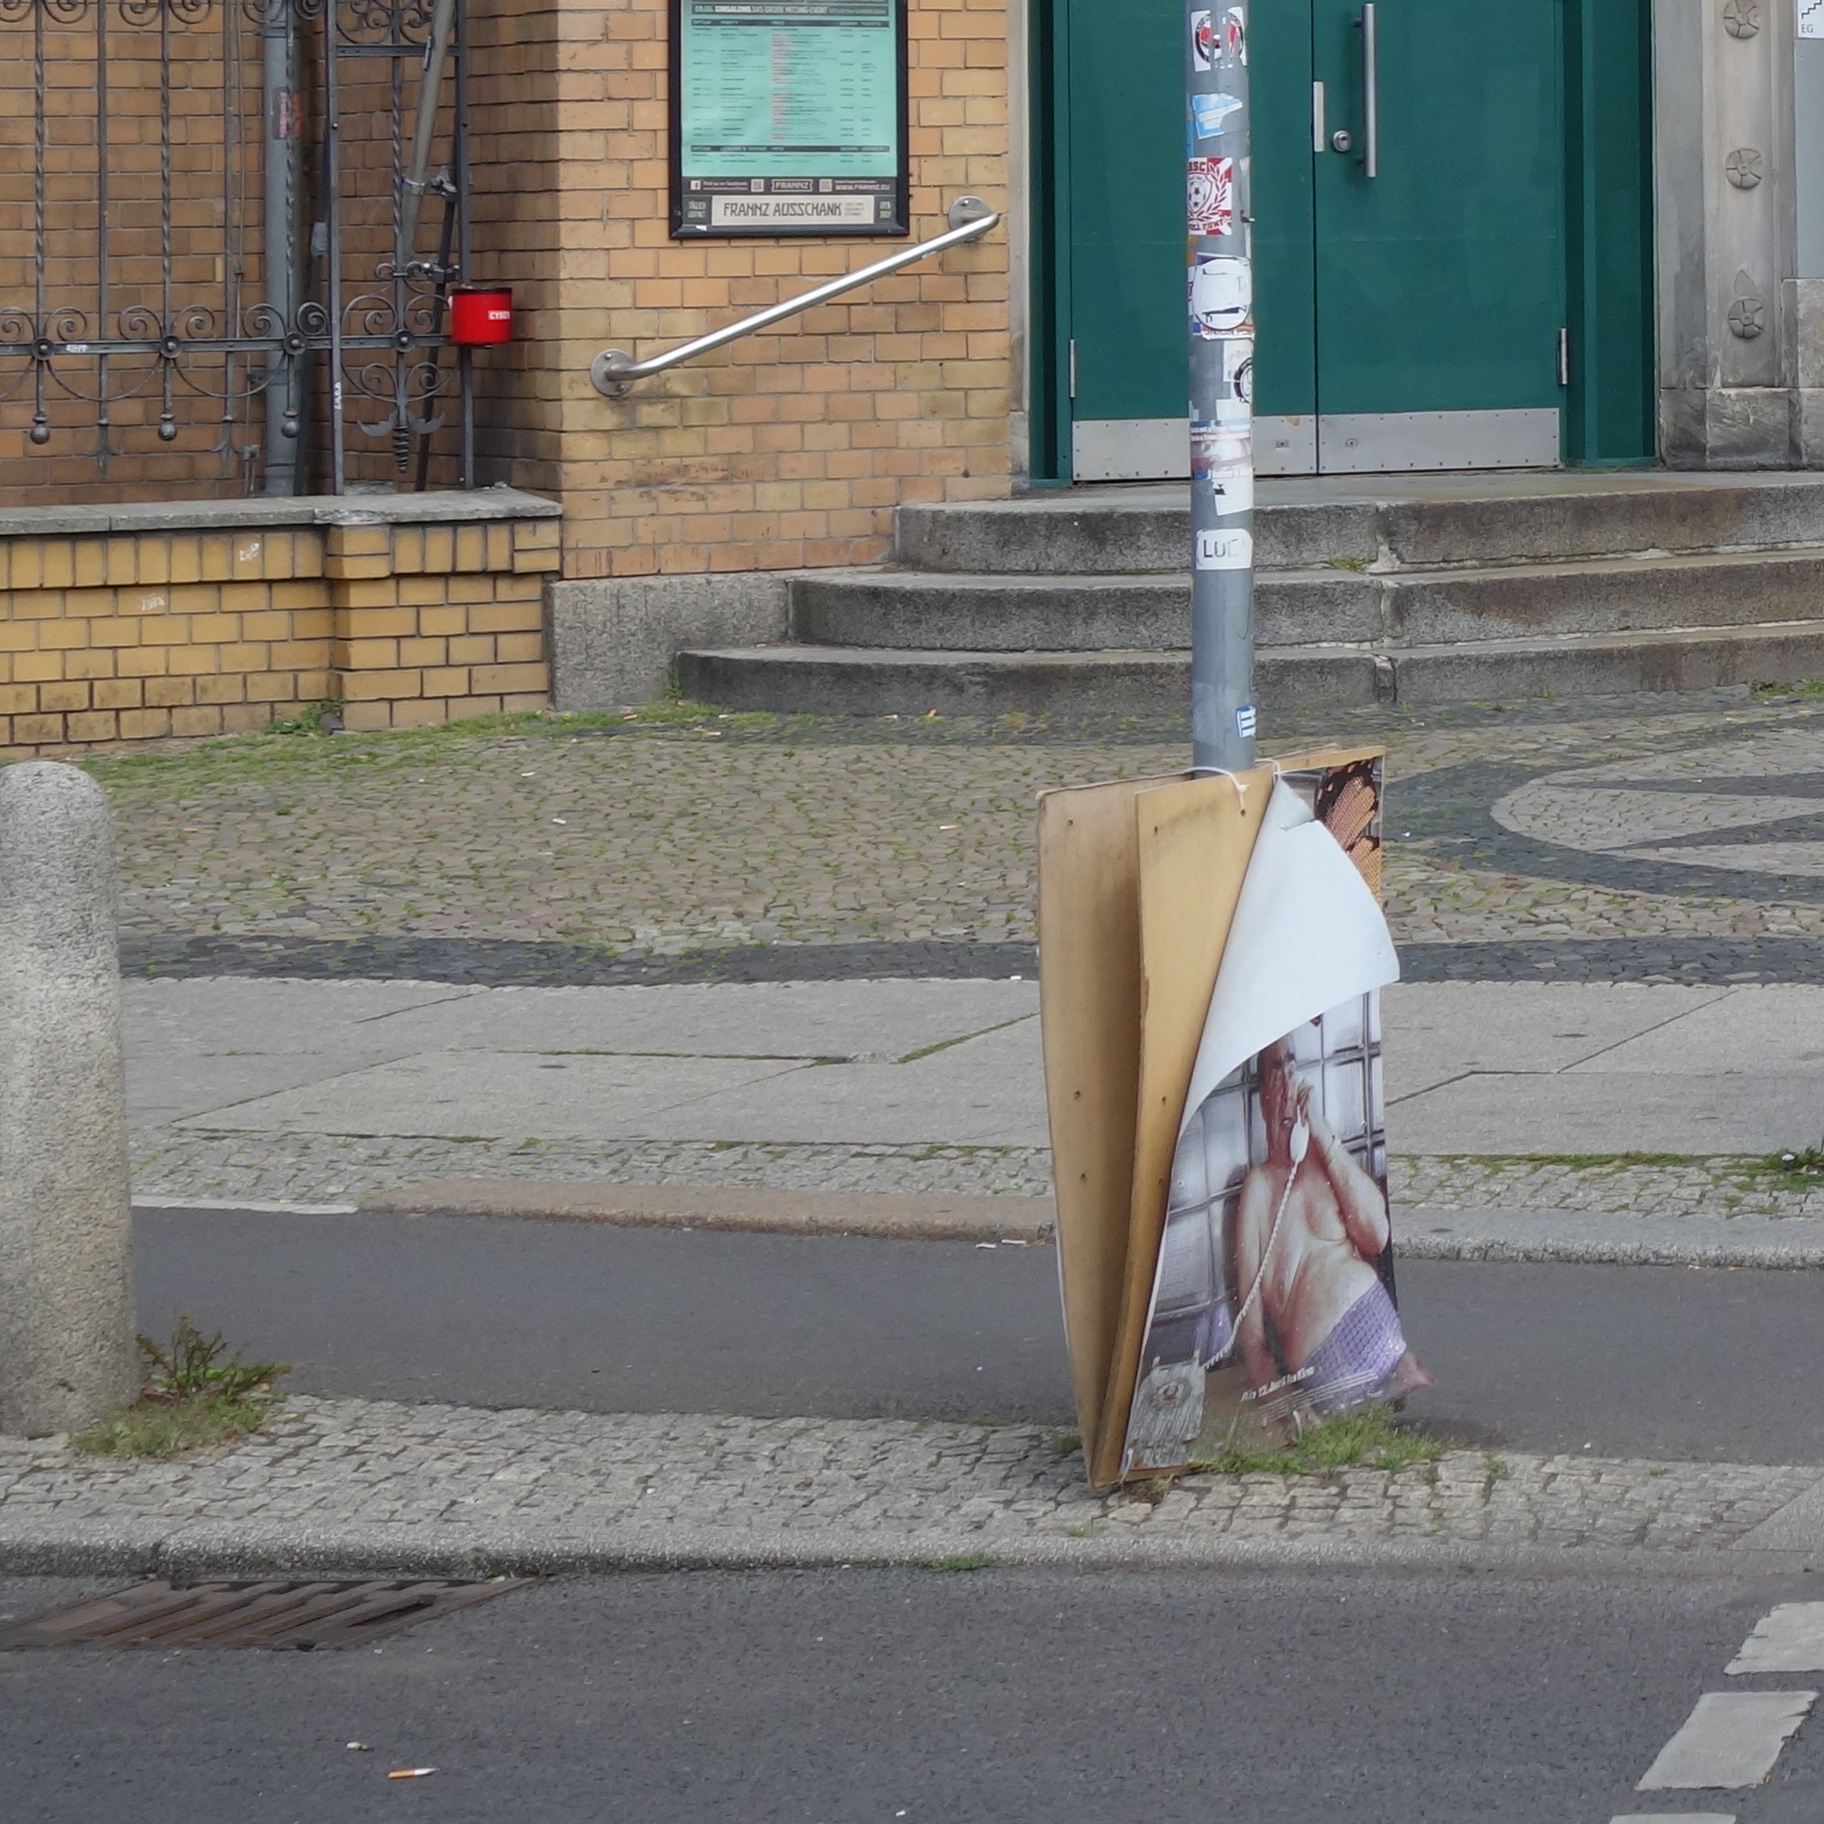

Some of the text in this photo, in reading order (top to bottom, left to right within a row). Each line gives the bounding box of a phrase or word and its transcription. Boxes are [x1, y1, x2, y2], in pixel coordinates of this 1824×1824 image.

[1801, 24, 1814, 33] EG
[723, 203, 770, 217] FRANNZ
[772, 202, 842, 217] AUSSCHANK
